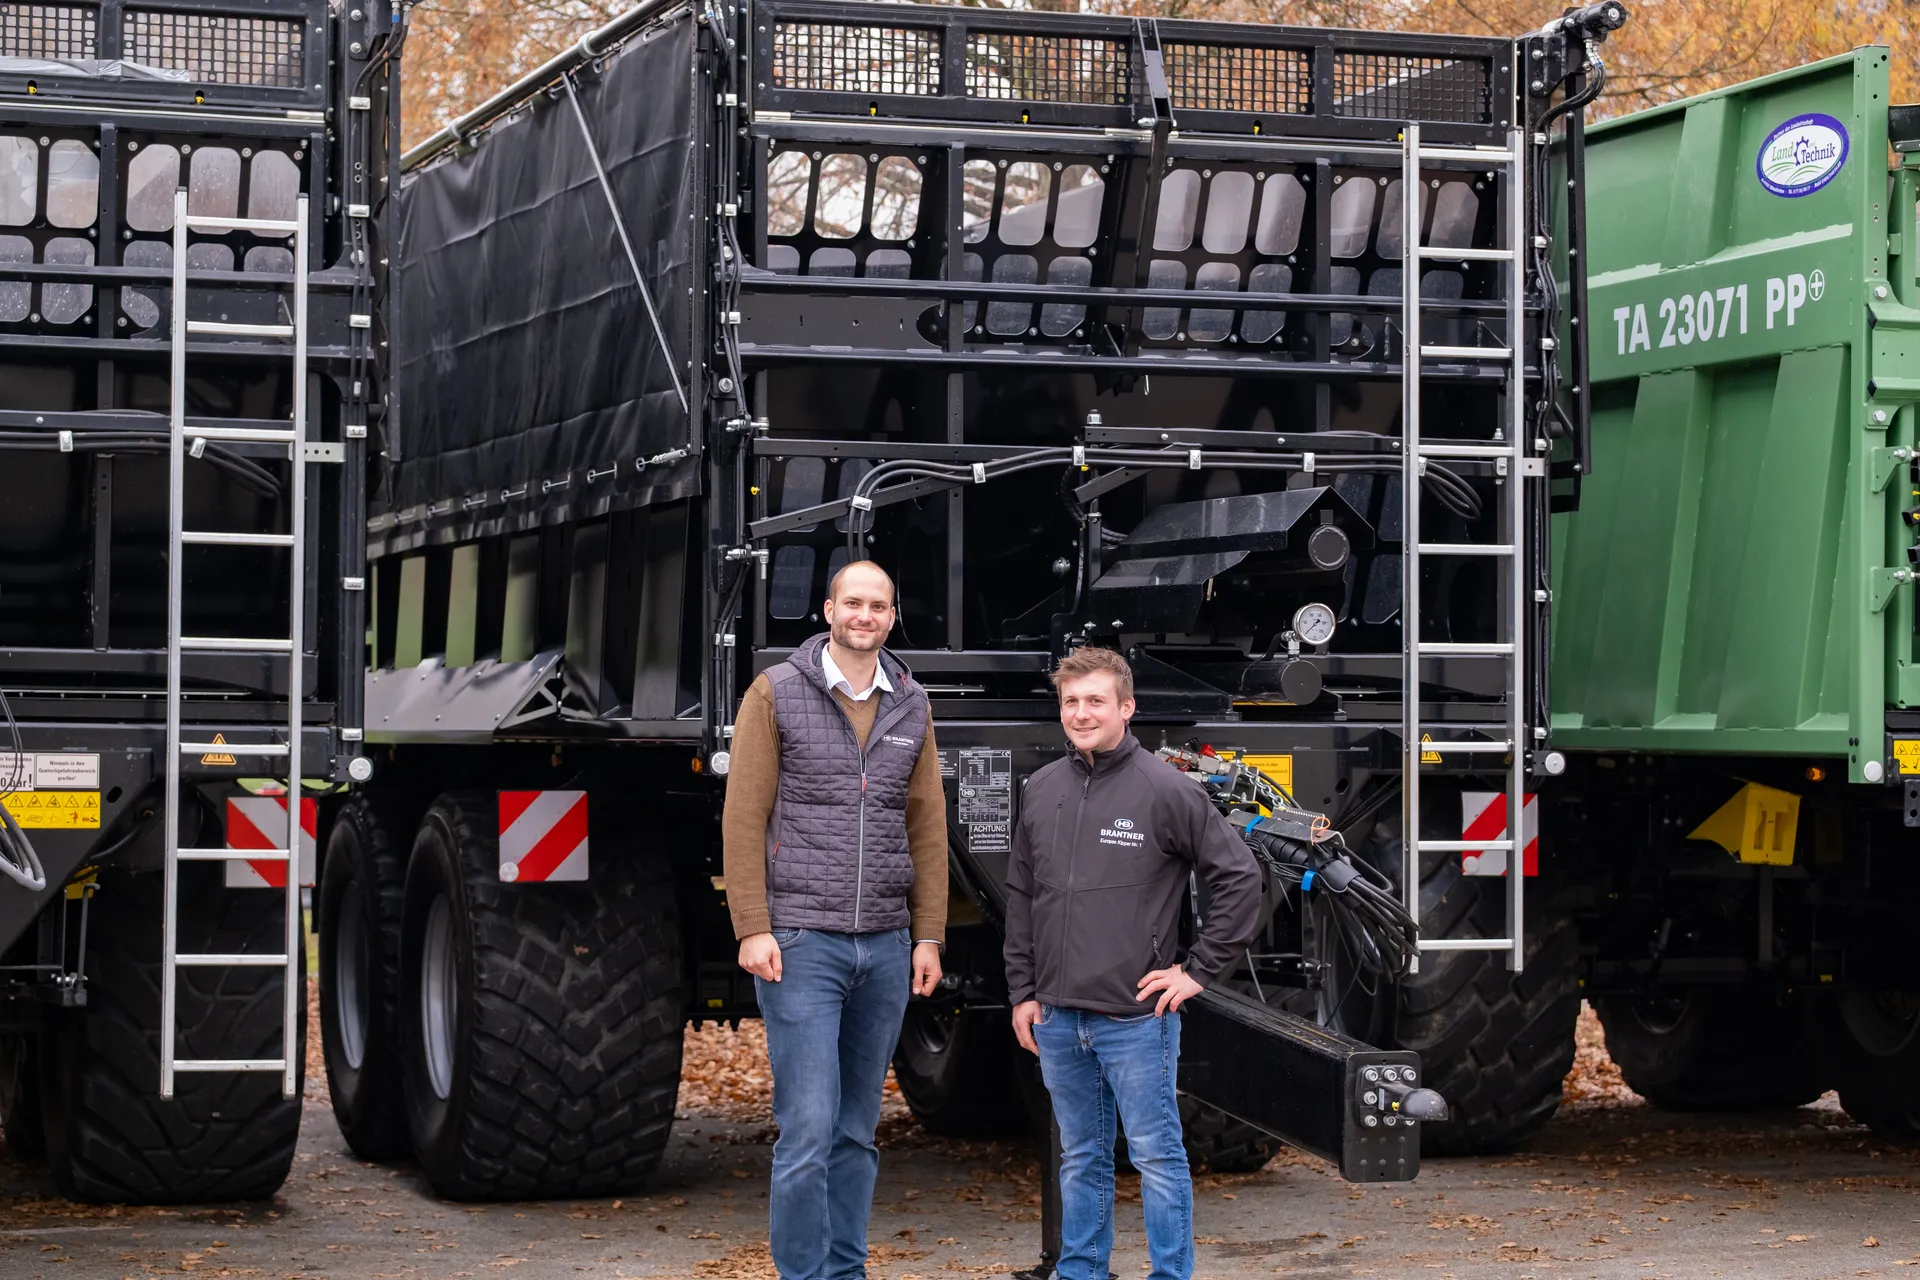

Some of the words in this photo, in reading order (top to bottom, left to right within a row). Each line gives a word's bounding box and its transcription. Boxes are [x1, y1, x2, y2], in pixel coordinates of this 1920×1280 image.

[1771, 141, 1794, 162] Land
[1801, 142, 1836, 164] Technik
[1613, 303, 1651, 355] TA
[1659, 283, 1748, 348] 23071
[1100, 829, 1144, 840] BRANTNER
